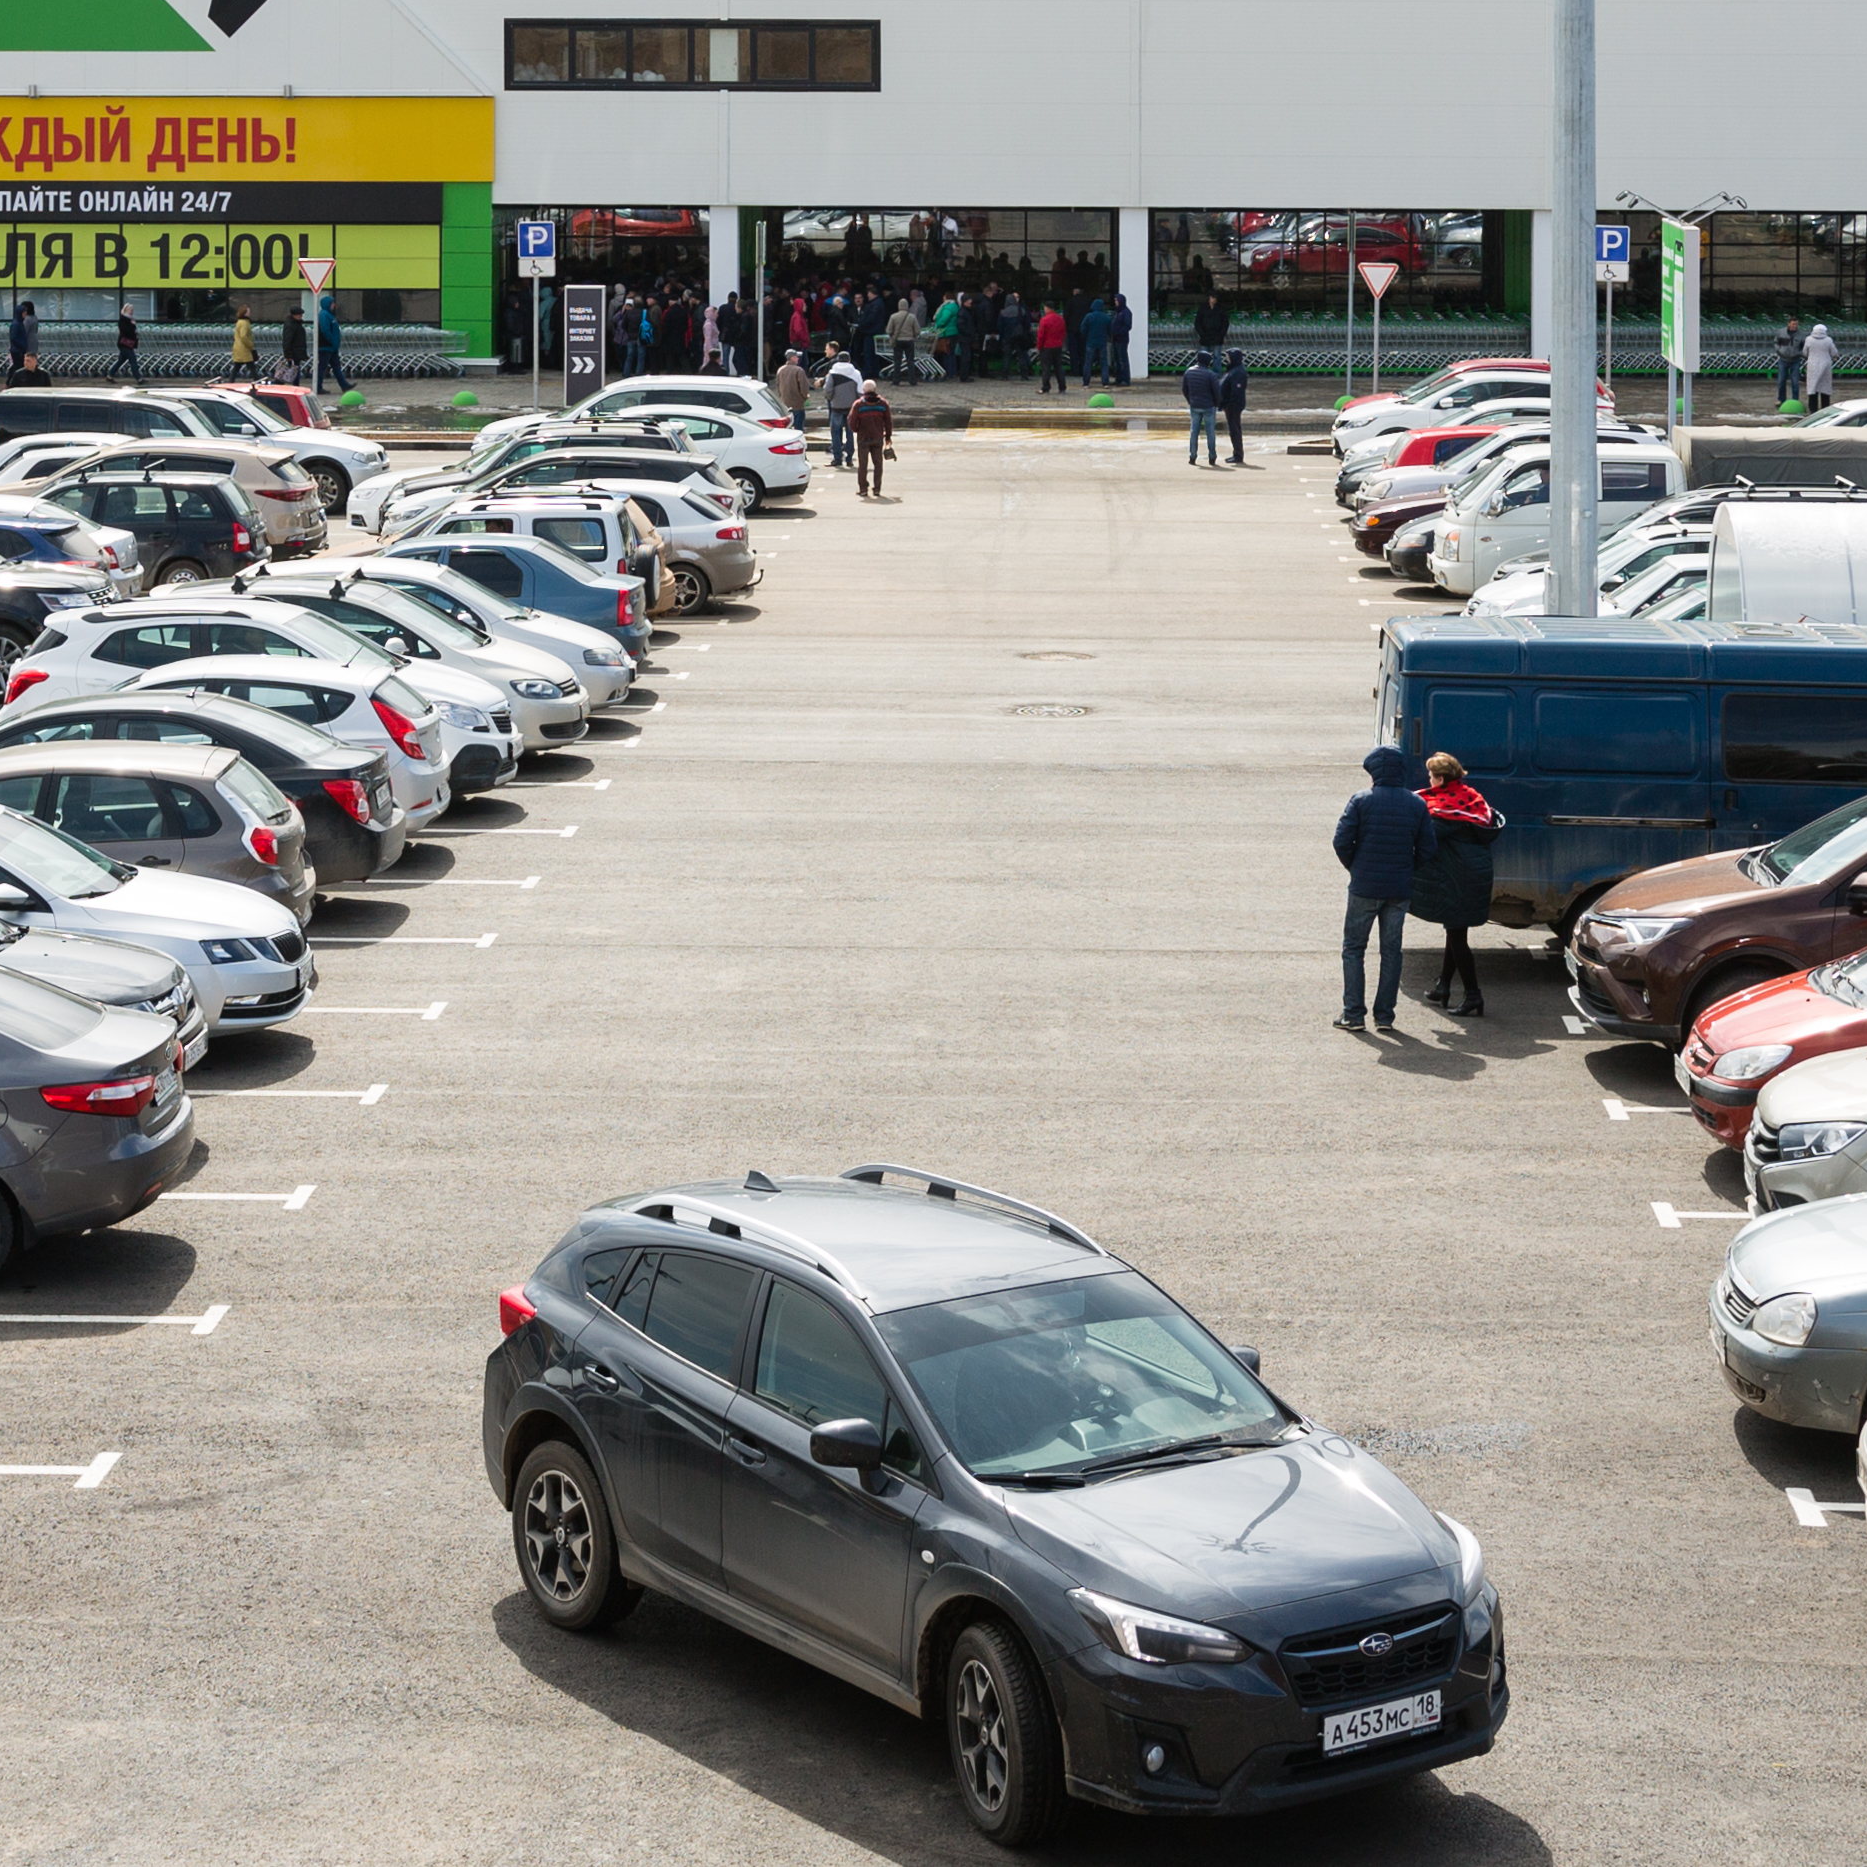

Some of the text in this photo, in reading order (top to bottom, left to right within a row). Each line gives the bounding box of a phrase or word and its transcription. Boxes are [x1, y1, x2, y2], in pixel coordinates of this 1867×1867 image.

[147, 117, 296, 173] ДЕНЬ!
[78, 185, 174, 212] ОНЛАЙН
[180, 190, 232, 213] 24/7
[94, 233, 130, 279] В
[1332, 1694, 1435, 1745] А453МС 18
